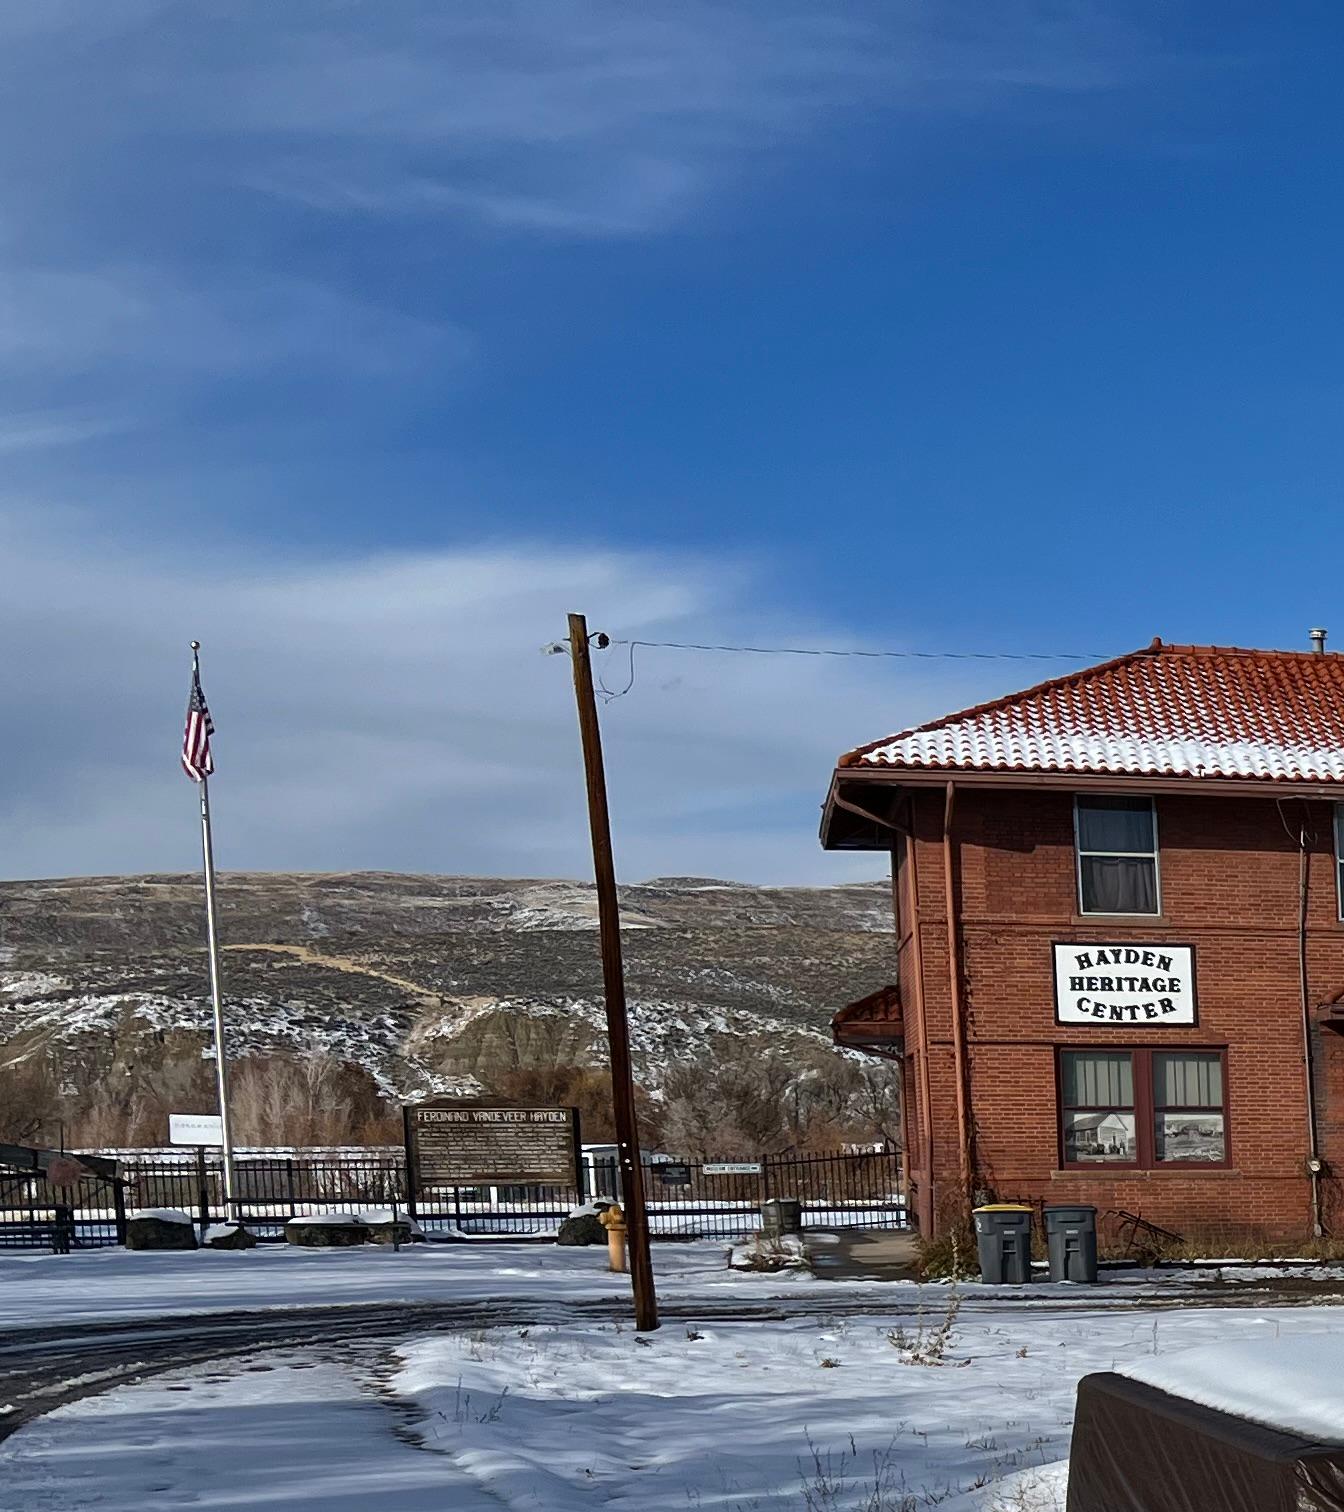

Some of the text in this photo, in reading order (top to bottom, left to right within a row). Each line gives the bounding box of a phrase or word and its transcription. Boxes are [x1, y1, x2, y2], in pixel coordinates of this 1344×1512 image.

[1074, 948, 1174, 973] HAYDEN
[1068, 975, 1182, 993] HERITAGE
[1076, 997, 1177, 1021] CENTER
[417, 1111, 567, 1122] FERDINAND VANDEVEER HAYDEN
